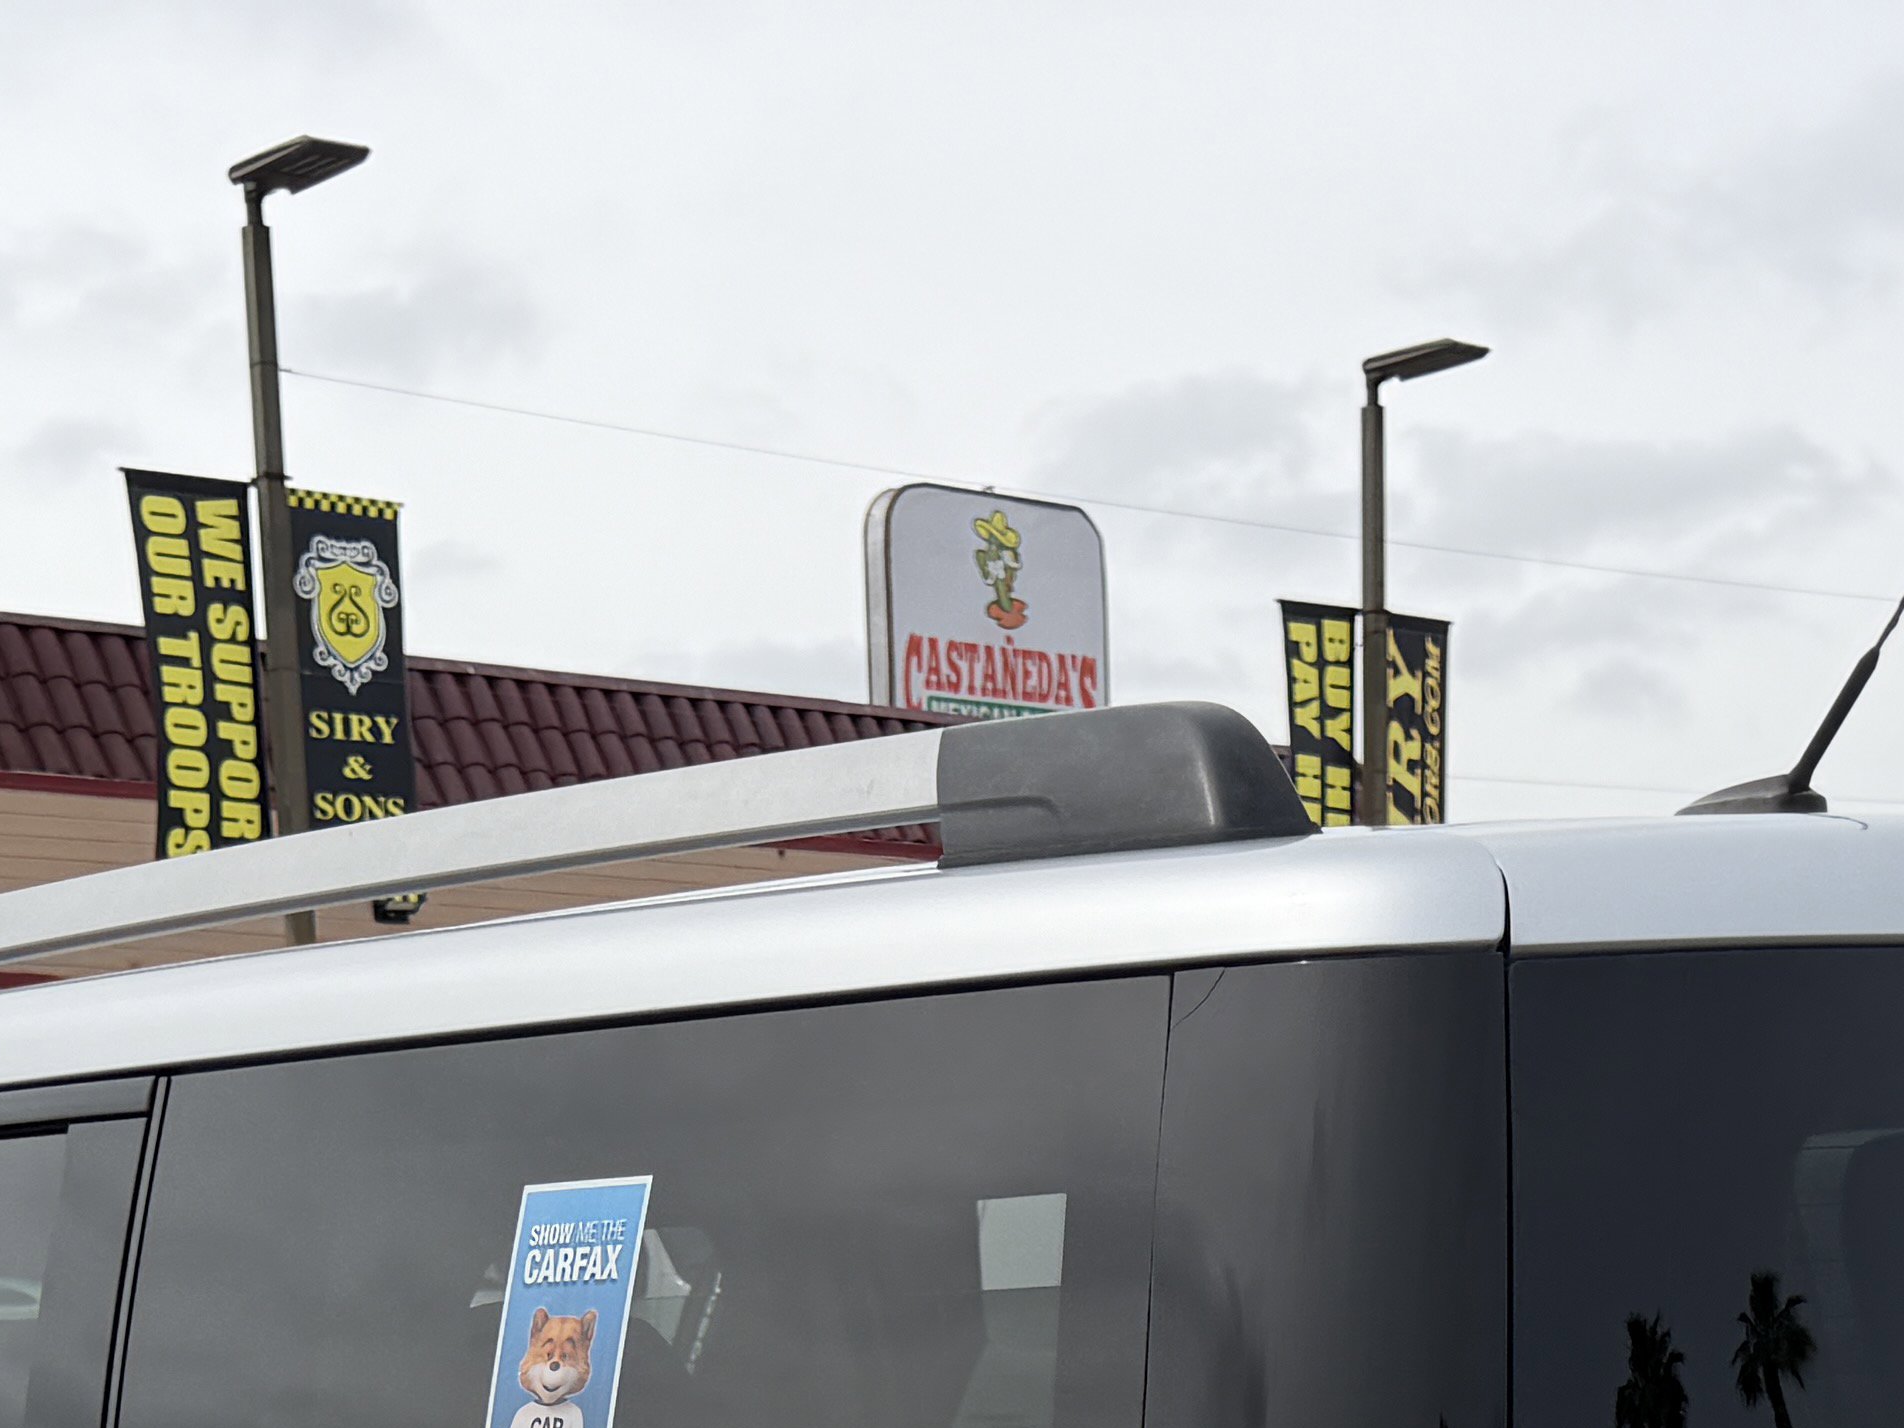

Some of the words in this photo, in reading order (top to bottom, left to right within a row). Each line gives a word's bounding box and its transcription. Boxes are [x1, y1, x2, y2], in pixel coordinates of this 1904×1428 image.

[140, 494, 195, 617] OUR
[196, 498, 247, 592] WE
[206, 603, 261, 841] SUPPOR
[308, 710, 399, 746] SIRY
[1288, 622, 1322, 740] PAY
[1320, 619, 1351, 751] BUY
[156, 632, 211, 857] TROOPS
[342, 754, 374, 781] &
[313, 792, 406, 823] SONS
[523, 1244, 624, 1285] CARFAX
[529, 1222, 575, 1246] SHOW
[575, 1220, 597, 1243] ME
[601, 1218, 627, 1241] THE
